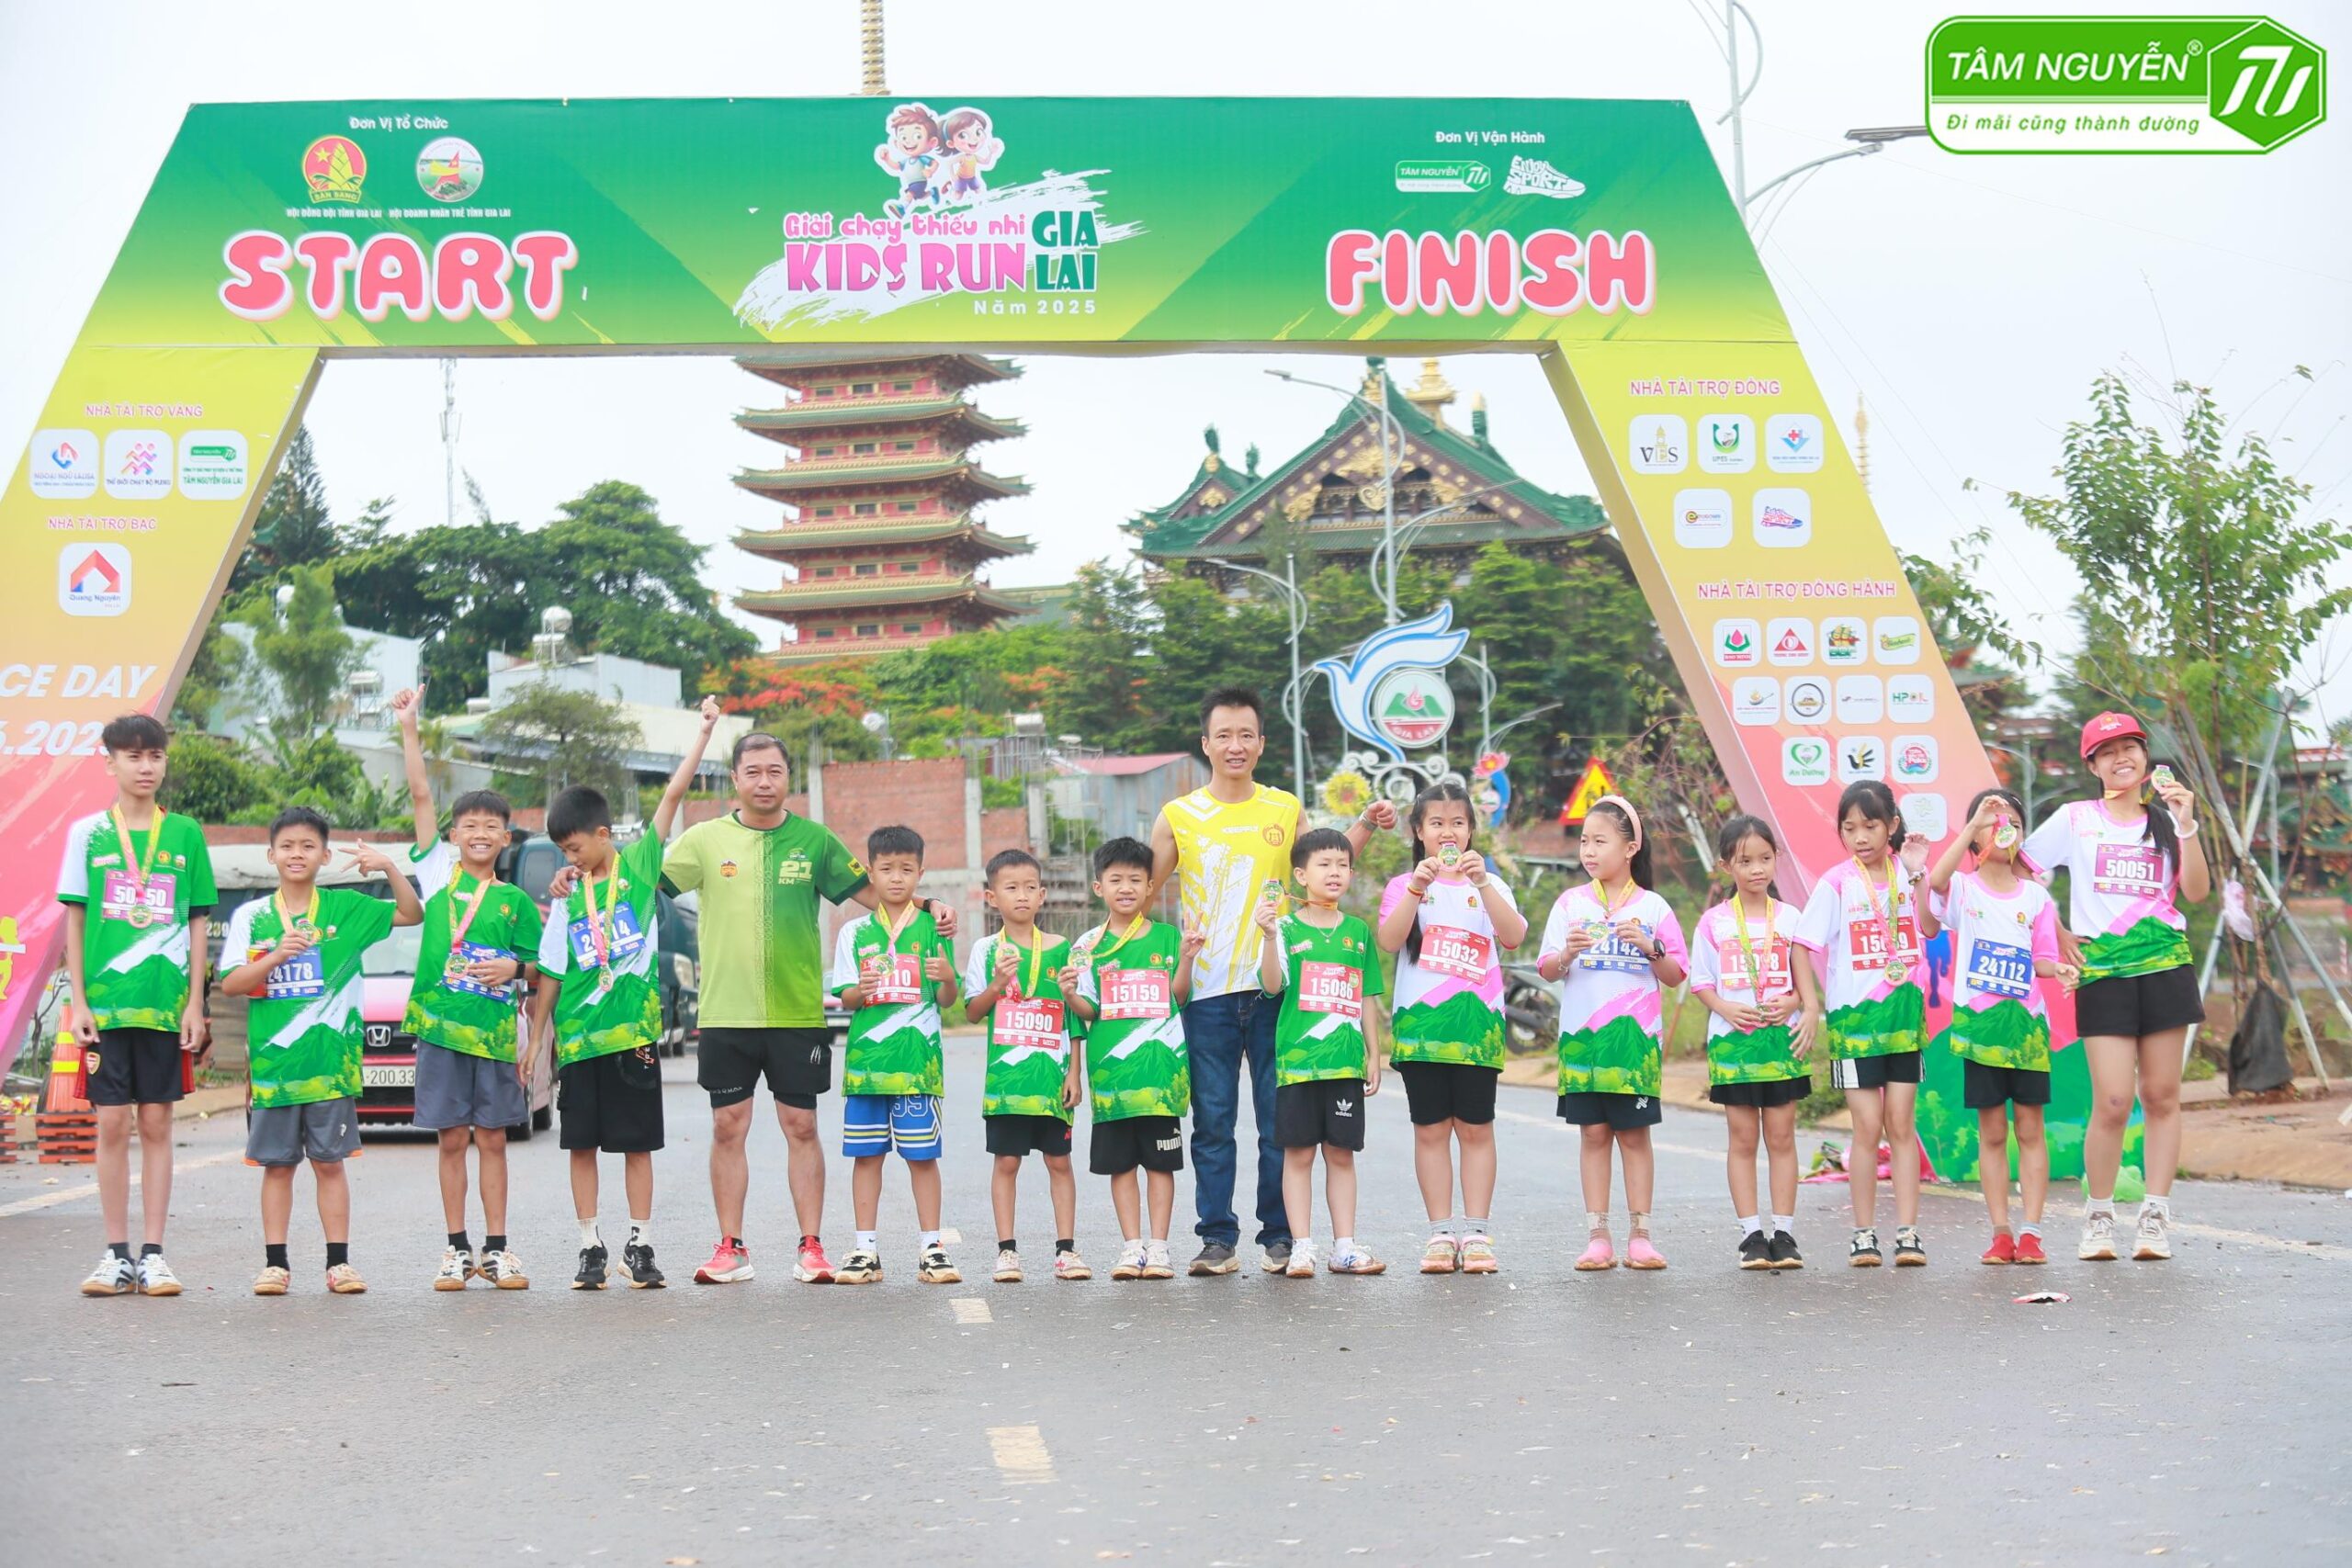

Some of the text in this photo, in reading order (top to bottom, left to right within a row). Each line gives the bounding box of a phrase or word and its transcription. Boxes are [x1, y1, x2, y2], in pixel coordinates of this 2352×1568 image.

[349, 117, 376, 130] Đơn
[379, 117, 392, 132] Vị
[413, 117, 449, 130] Chức
[1435, 130, 1545, 146] Đơn Vị Vận Hành
[785, 212, 1026, 243] Giải chạy thiếu nhi
[1031, 210, 1099, 248] GIA
[221, 231, 577, 321] START
[785, 243, 1026, 295] KIDS RUN
[1035, 253, 1097, 292] LAI
[1326, 229, 1656, 317] FINISH
[974, 299, 1096, 315] Năm 2025
[1631, 378, 1664, 395] NHÀ
[1668, 378, 1692, 395] TÀI
[1697, 380, 1731, 399] TRỢ
[85, 402, 204, 420] NHÀ TÀI TRỢ VÀNG
[49, 516, 74, 530] NHÀ
[79, 516, 97, 530] TÀI
[1698, 581, 1731, 598] NHÀ
[1736, 581, 1760, 598] TÀI
[1765, 582, 1798, 602] TRỢ
[1852, 579, 1896, 597] HÀNH
[62, 665, 158, 698] DAY
[779, 861, 813, 879] 21
[2105, 859, 2155, 881] 50051
[114, 885, 167, 907] 5050
[1433, 939, 1479, 966] 15032
[1978, 955, 2026, 982] 24112
[1111, 984, 1159, 1003] 15159
[1311, 977, 1354, 1000] 15086
[1006, 1010, 1053, 1032] 15090
